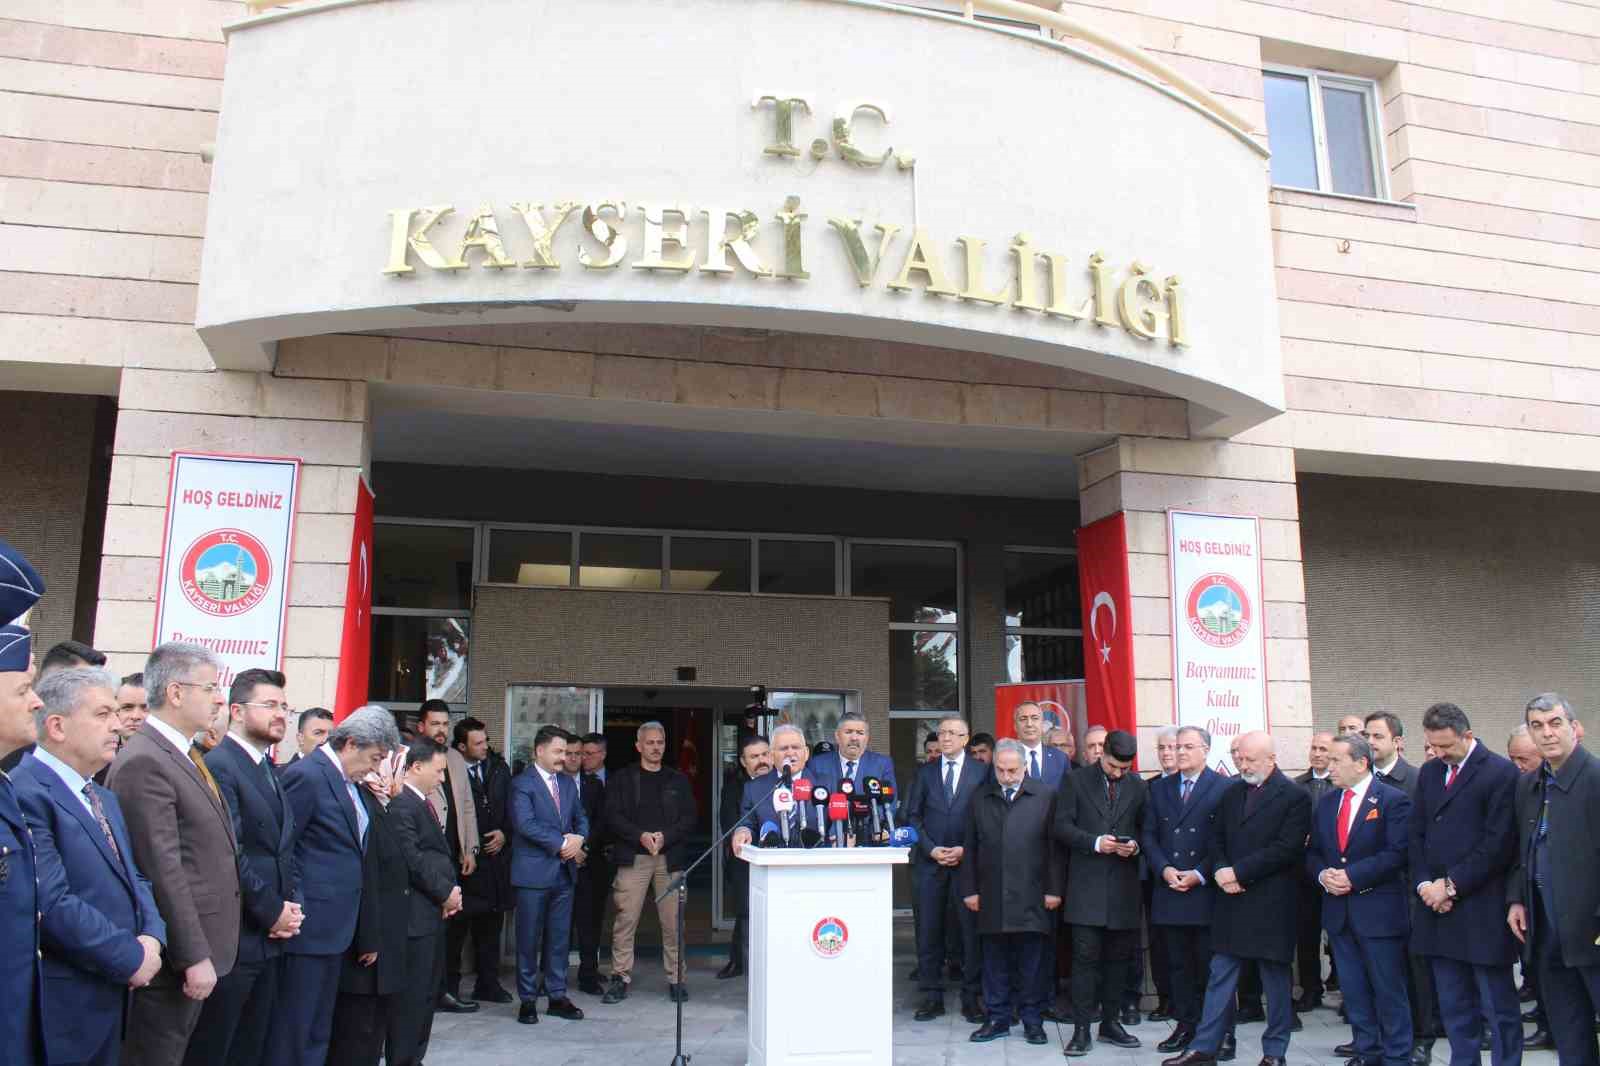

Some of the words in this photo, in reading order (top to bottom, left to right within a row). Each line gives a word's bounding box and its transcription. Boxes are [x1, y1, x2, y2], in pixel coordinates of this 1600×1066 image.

[751, 94, 914, 169] T.C.
[382, 195, 811, 279] KAYSERİ
[828, 214, 1191, 348] VALİLİĞİ
[183, 489, 213, 509] HOŞ
[217, 489, 283, 510] GELDİNİZ
[1179, 539, 1202, 556] HOŞ
[183, 580, 221, 613] KAYSERİ
[1206, 689, 1240, 708] Kutlu
[1206, 716, 1242, 737] Olsun
